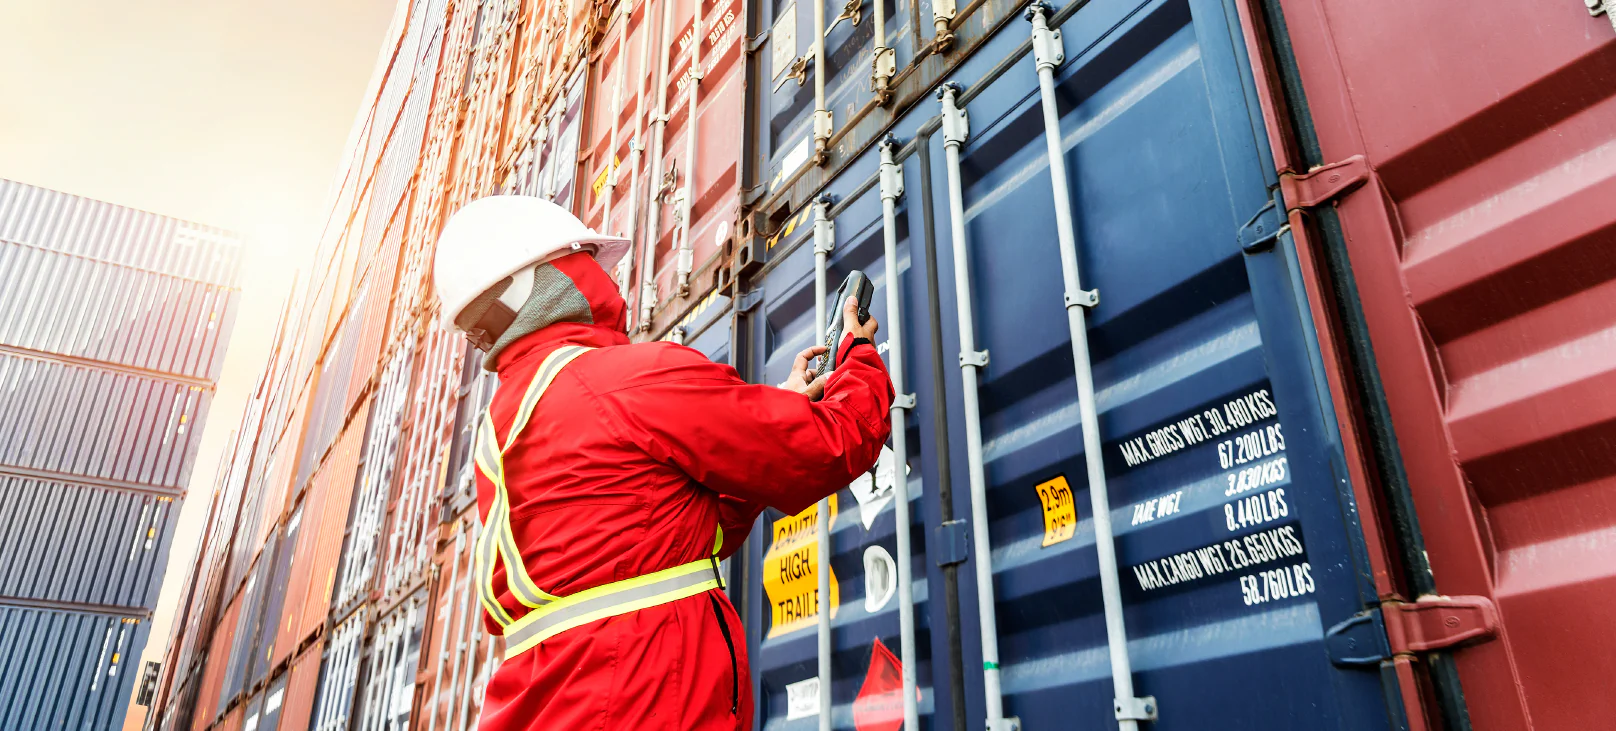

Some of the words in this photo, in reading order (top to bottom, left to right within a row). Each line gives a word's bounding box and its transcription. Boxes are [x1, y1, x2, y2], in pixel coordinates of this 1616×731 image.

[1119, 424, 1185, 467] MAX.GROSS
[1177, 414, 1212, 445] WGT.
[1131, 498, 1158, 526] TARE
[780, 548, 812, 584] HIGH
[1133, 551, 1204, 591] MAX.CARGO
[1195, 544, 1233, 576] WGT.
[778, 589, 819, 624] TRAILE
